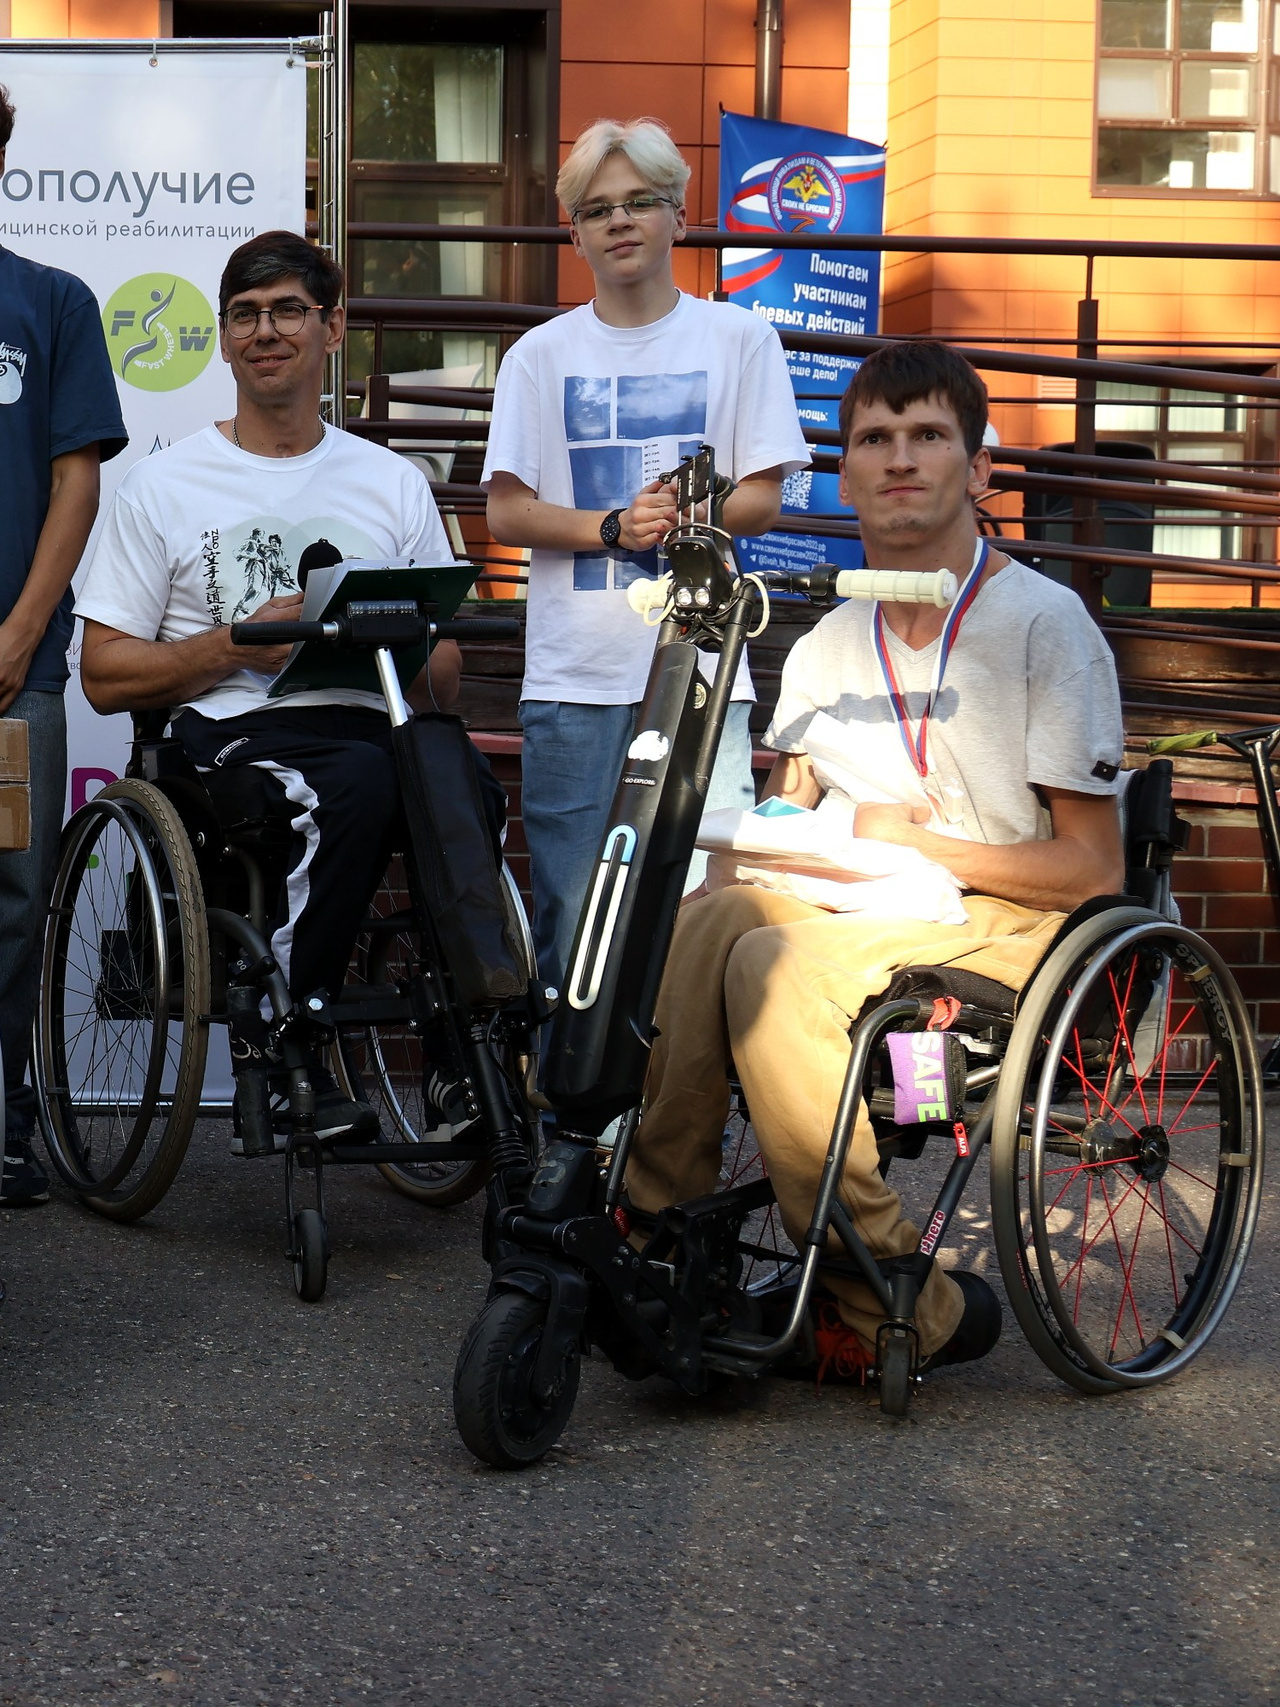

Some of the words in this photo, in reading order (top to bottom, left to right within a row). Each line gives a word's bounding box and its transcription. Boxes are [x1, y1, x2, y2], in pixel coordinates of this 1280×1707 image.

[106, 222, 256, 241] реабилитации
[810, 252, 869, 283] Помогаем
[793, 282, 867, 310] участникам
[806, 310, 865, 335] действий
[784, 349, 797, 360] ас
[799, 352, 810, 362] за
[812, 353, 862, 371] поддержку
[812, 369, 838, 381] дело!
[911, 1031, 948, 1122] SAFE
[957, 1136, 969, 1155] ALFA
